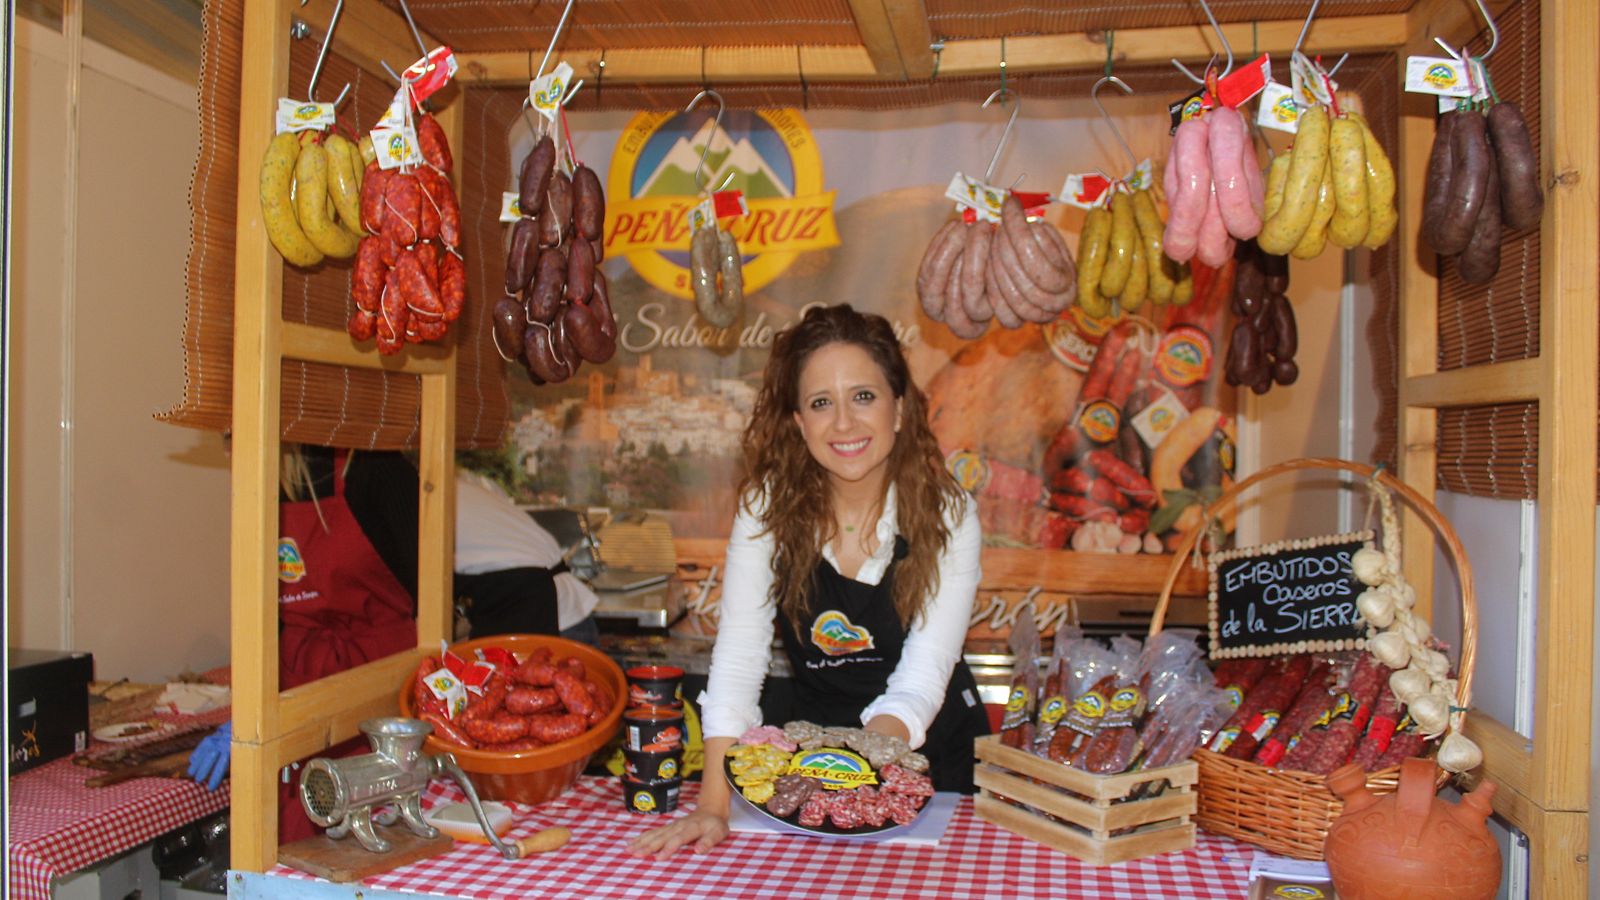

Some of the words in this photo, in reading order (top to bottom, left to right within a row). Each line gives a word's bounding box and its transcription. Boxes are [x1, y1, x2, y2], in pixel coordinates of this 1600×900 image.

[739, 312, 773, 348] de
[1225, 551, 1354, 593] EMBUTIDOS
[1221, 609, 1242, 638] de
[1247, 603, 1268, 633] la
[835, 771, 874, 782] CRUZ
